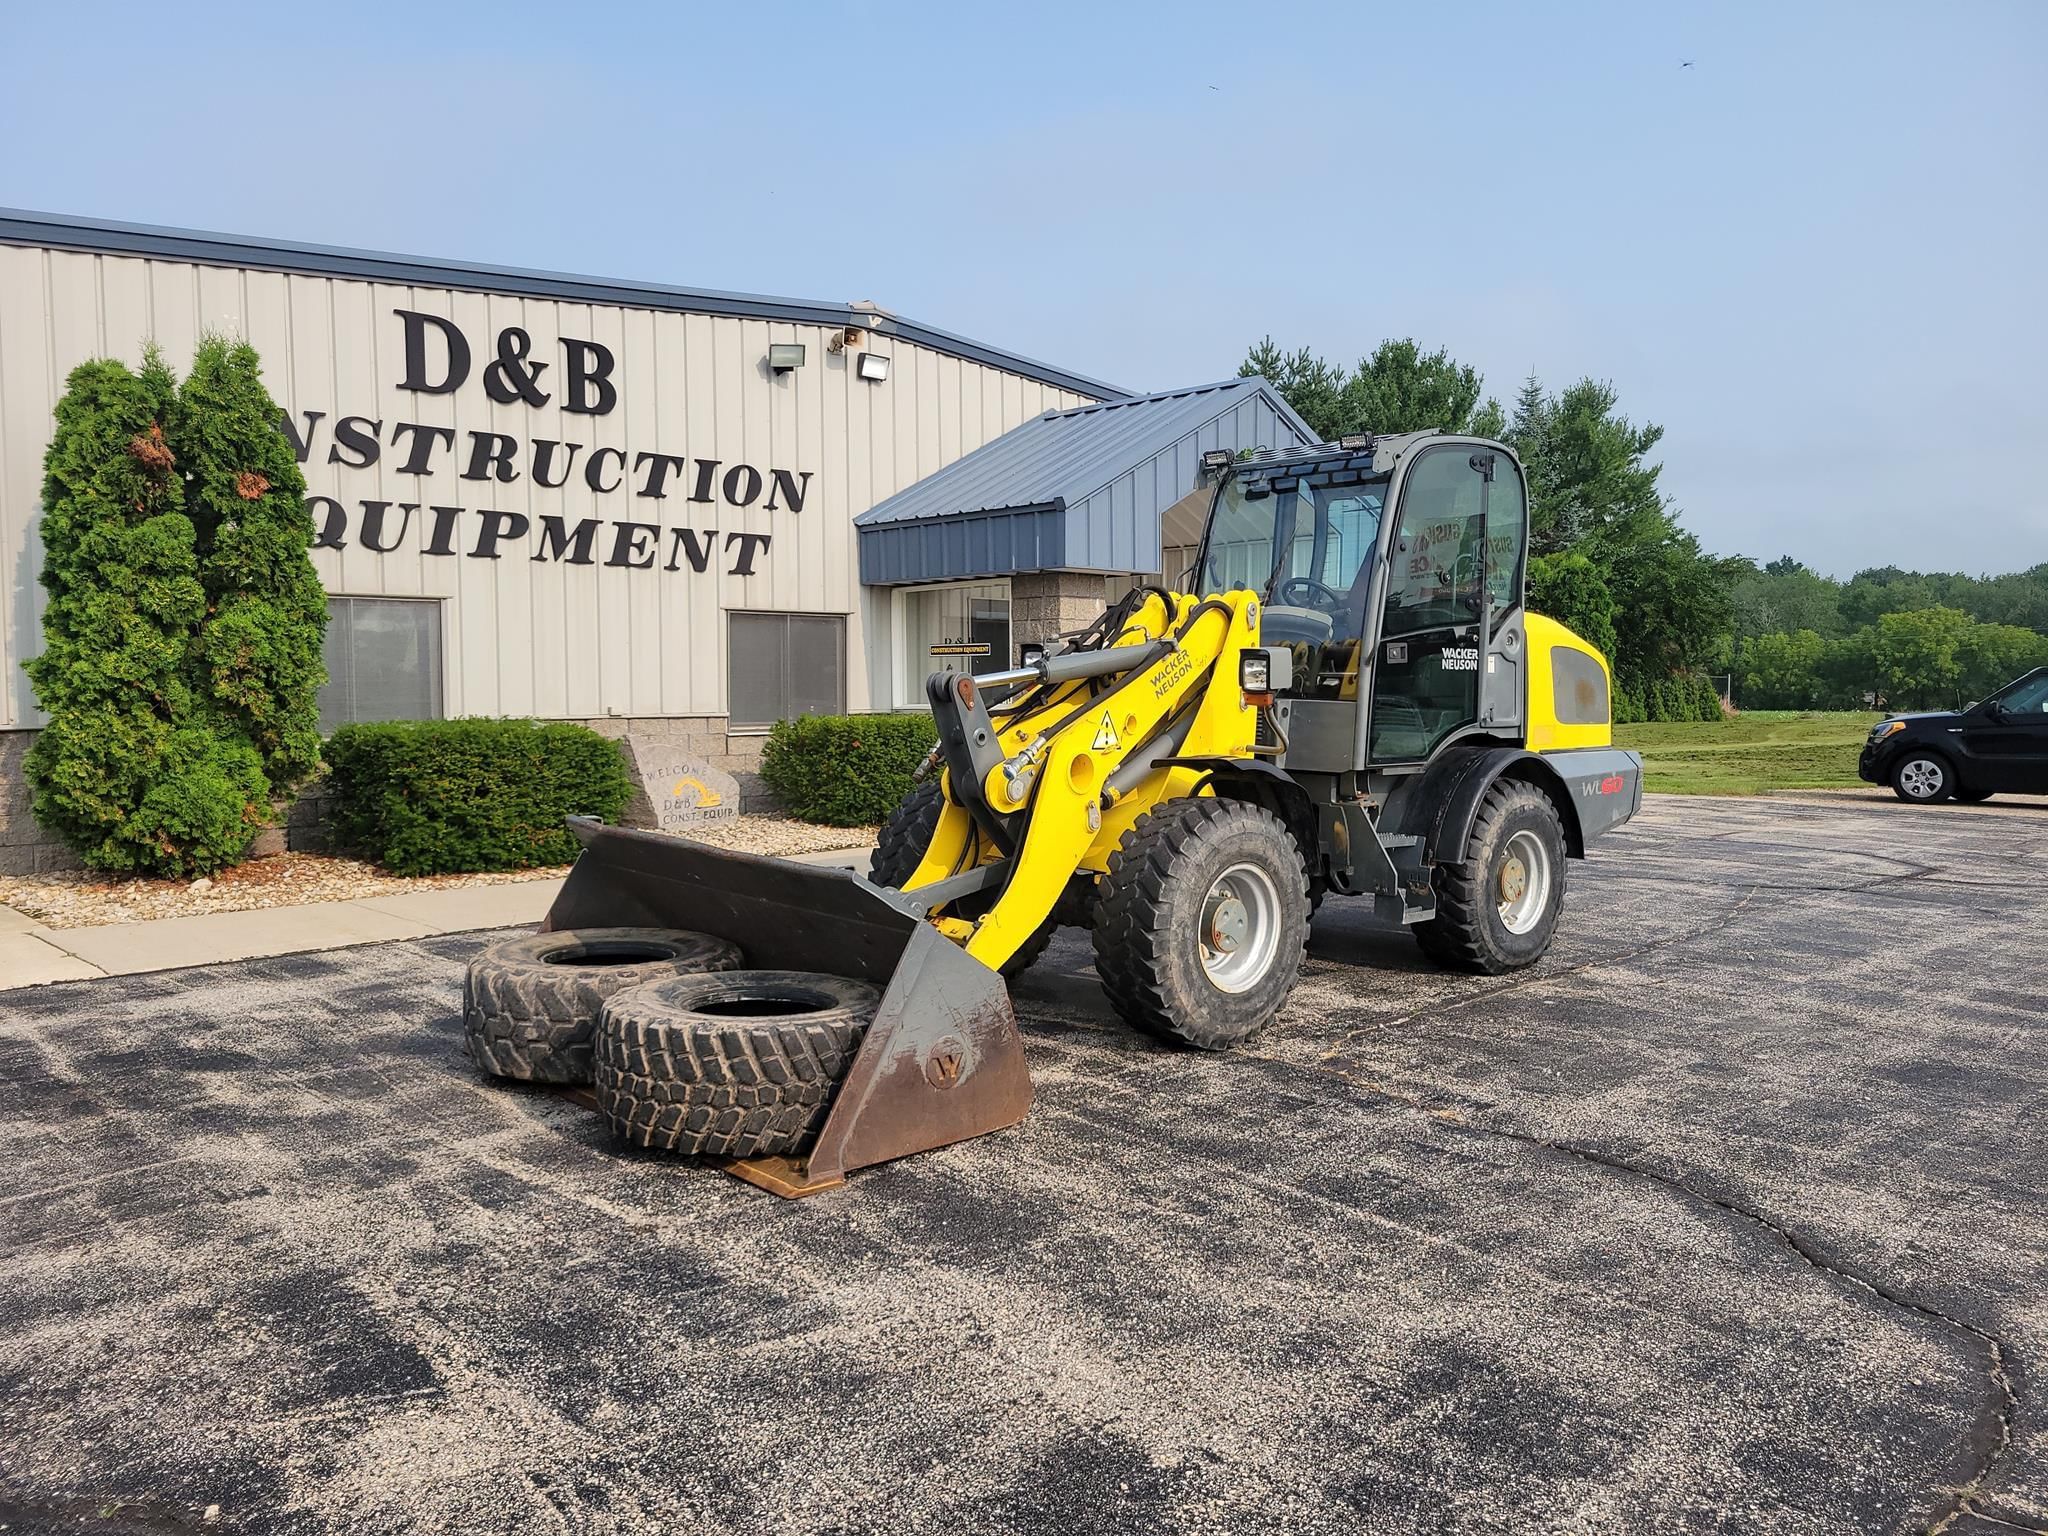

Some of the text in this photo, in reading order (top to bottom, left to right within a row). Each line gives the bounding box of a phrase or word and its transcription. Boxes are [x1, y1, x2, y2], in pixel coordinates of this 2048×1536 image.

[393, 309, 617, 415] D&B
[279, 407, 814, 513] NSTRUCTION
[304, 496, 771, 576] QUIPMENT
[1441, 647, 1479, 660] WACKER
[1441, 658, 1478, 671] NEUSON
[1150, 649, 1190, 686] WACKER
[1154, 661, 1193, 700] NEUSON
[646, 764, 708, 780] WELCOME
[664, 798, 691, 811] D&B
[703, 807, 735, 820] EQUIP.
